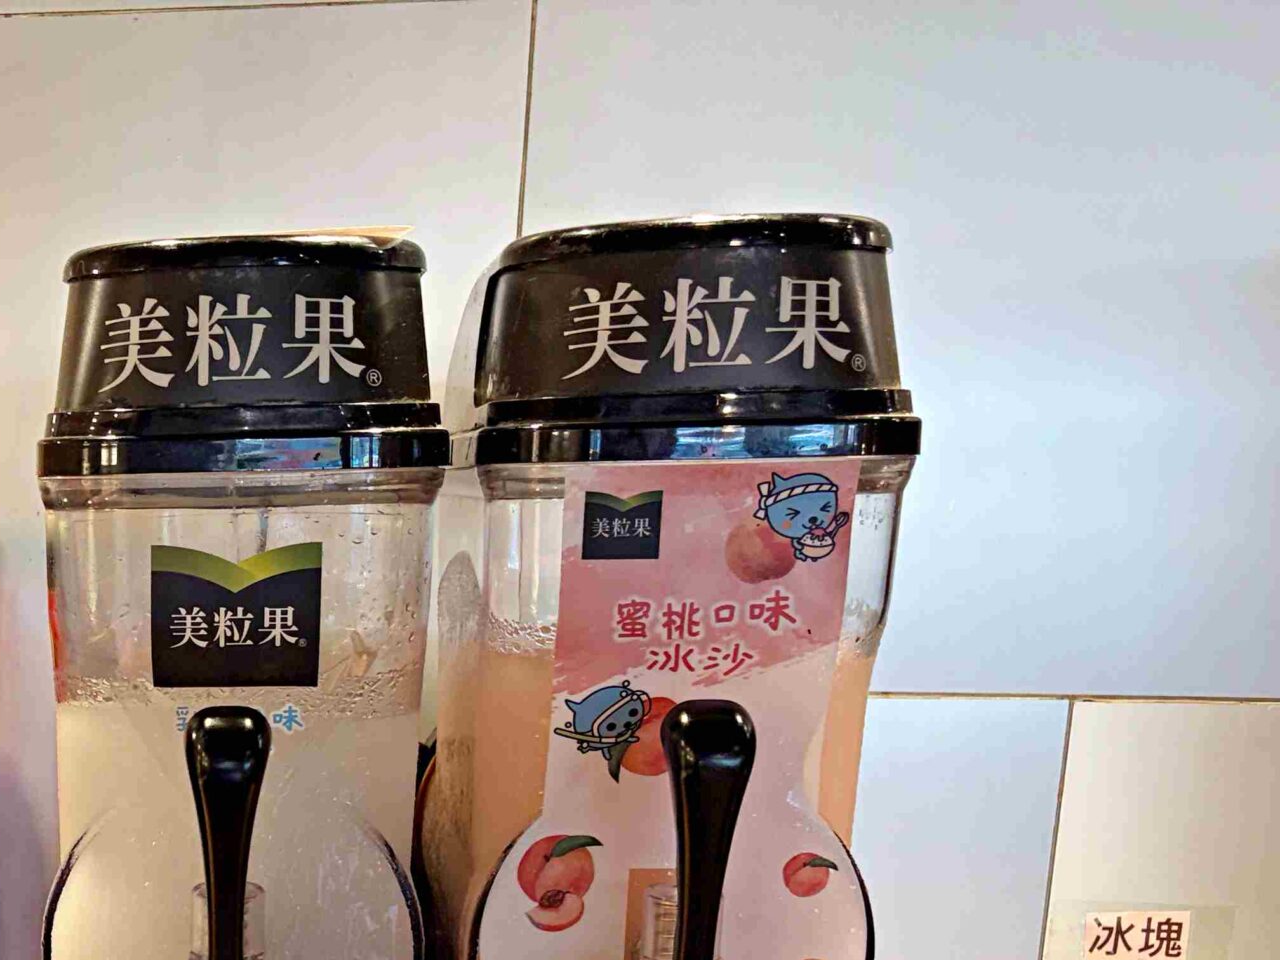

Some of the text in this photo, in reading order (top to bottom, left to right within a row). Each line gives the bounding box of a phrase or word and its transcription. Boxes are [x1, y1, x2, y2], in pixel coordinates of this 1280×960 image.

[97, 293, 367, 394] 美粒果
[561, 275, 852, 381] 美粒果
[590, 517, 652, 539] 美粒果
[169, 606, 301, 650] 美粒果
[616, 589, 797, 640] 蜜桃口味
[646, 643, 754, 676] 冰沙
[1088, 916, 1183, 958] 冰塊
